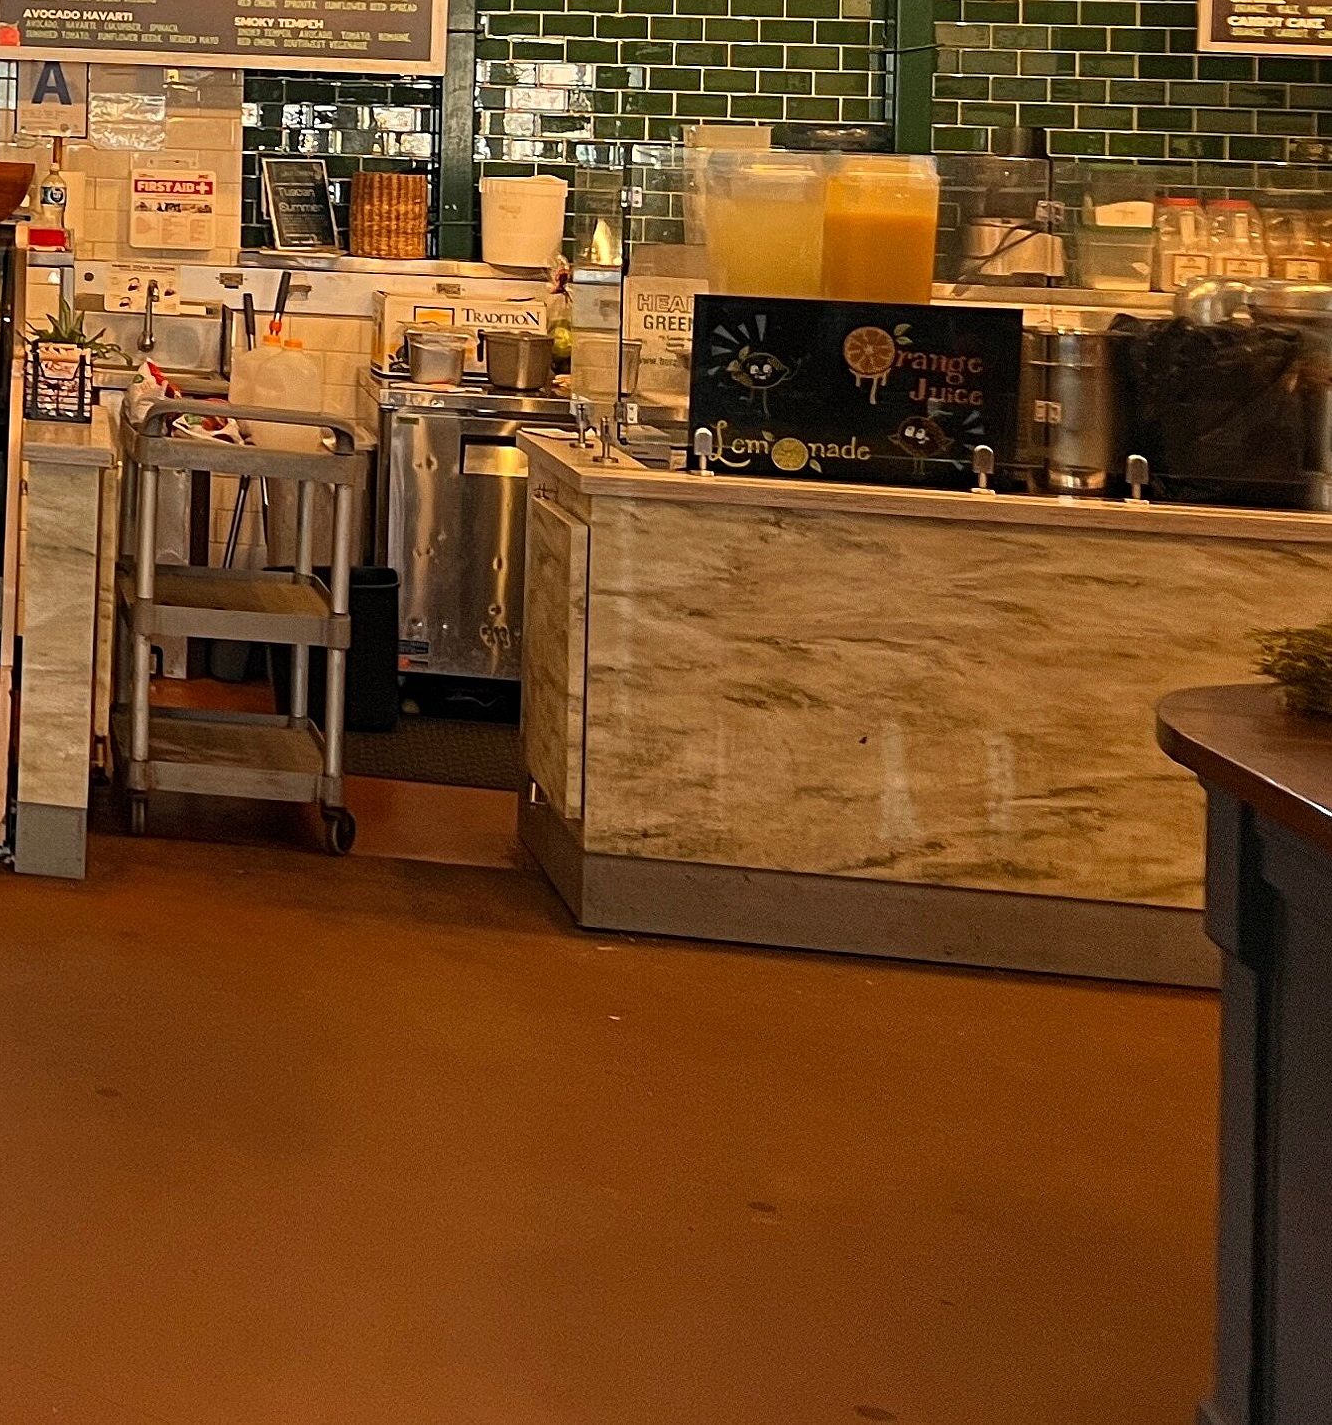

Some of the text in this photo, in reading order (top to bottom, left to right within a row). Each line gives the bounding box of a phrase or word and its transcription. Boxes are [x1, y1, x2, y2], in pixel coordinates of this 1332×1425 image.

[23, 9, 133, 21] AVOCADO HAVARTI
[235, 16, 323, 29] SMOKY TEMPEH
[31, 61, 73, 106] A
[136, 180, 196, 193] FIRST AID
[461, 307, 542, 326] TRADITION
[908, 377, 984, 407] Juice
